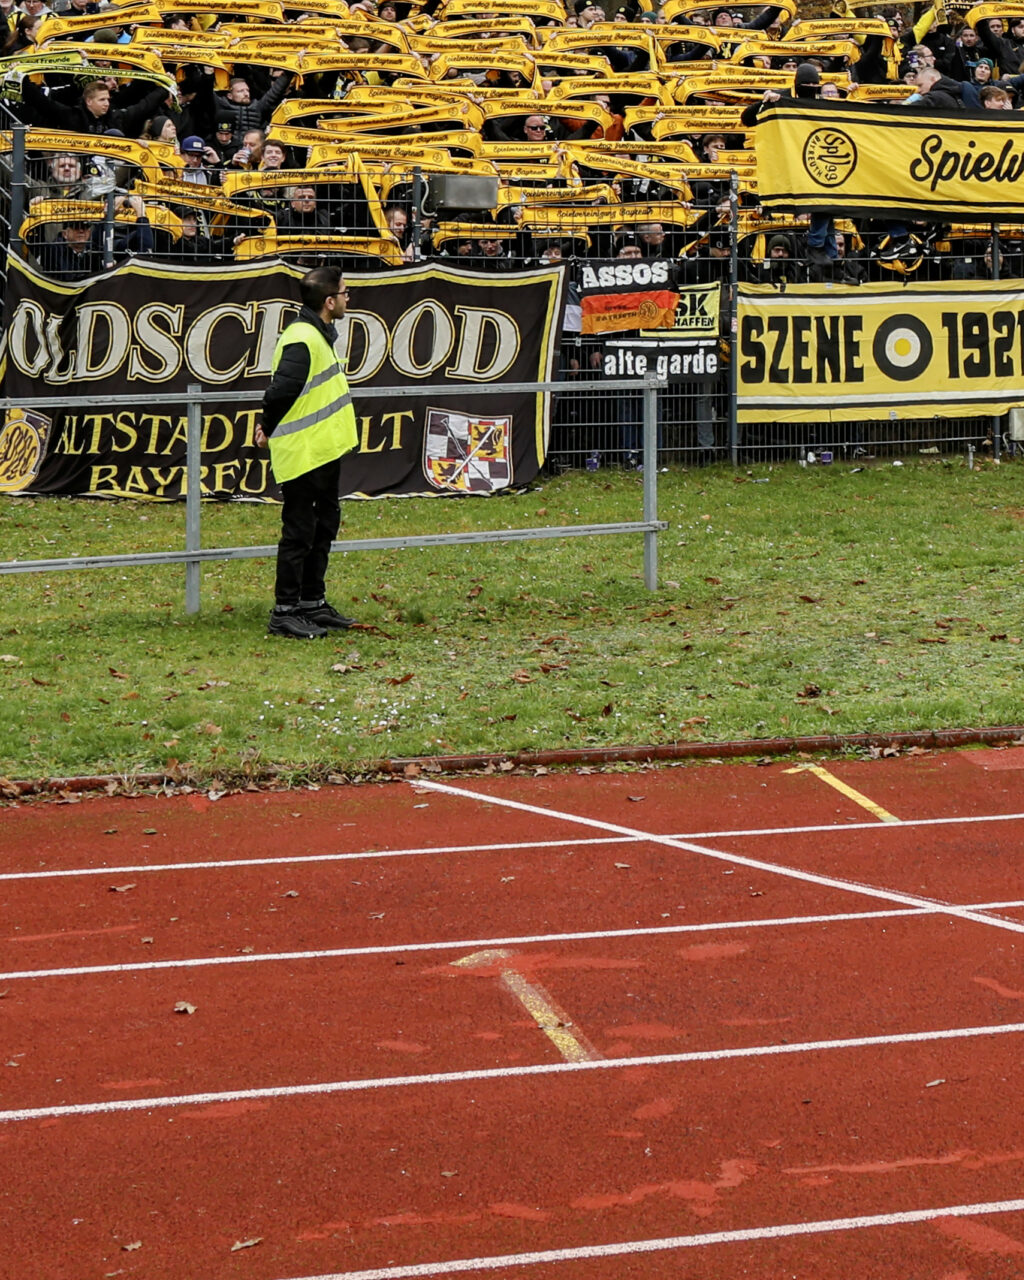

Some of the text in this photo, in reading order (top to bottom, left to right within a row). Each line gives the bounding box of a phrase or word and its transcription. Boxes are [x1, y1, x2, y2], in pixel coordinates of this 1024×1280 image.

[808, 135, 823, 177] BAYREUTH
[817, 133, 851, 181] SpVgg
[581, 261, 669, 289] ASSOS
[604, 348, 718, 380] alte garde
[741, 315, 864, 383] SZENE
[89, 458, 273, 496] BAYREU
